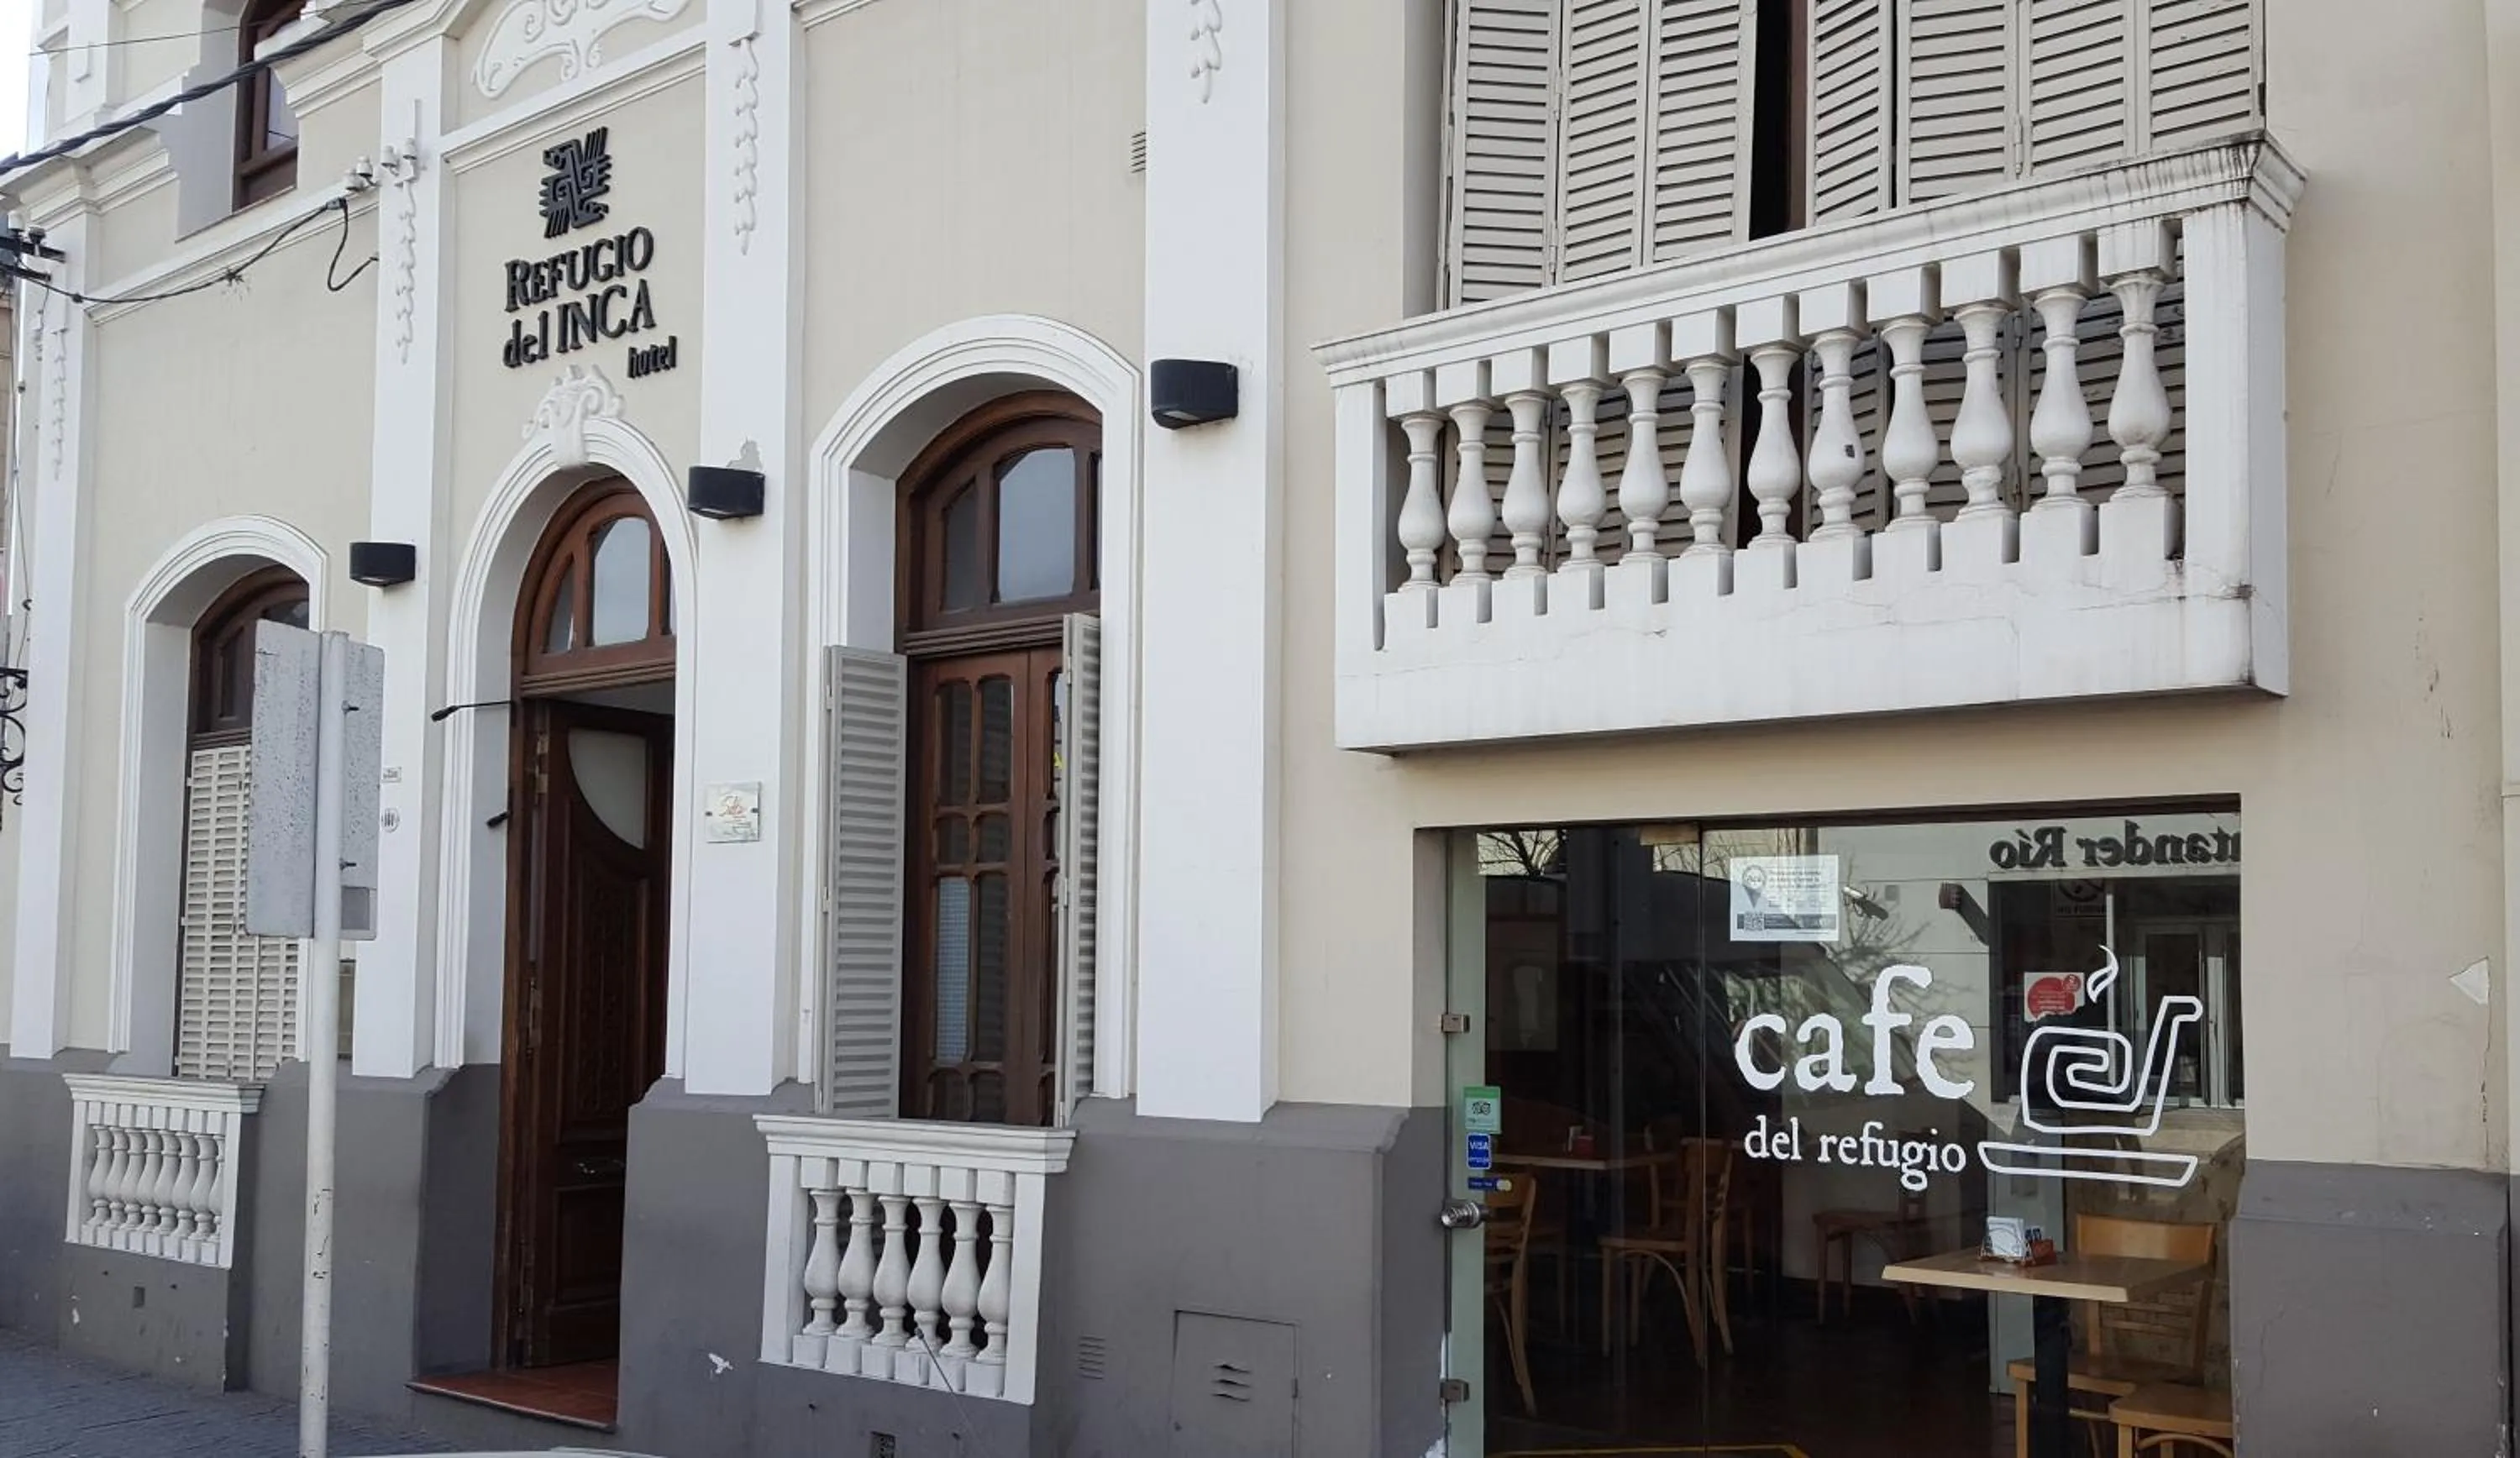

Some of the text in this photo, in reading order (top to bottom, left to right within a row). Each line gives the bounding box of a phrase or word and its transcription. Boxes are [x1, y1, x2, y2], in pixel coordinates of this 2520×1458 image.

[504, 226, 654, 313] REFUGIO
[502, 278, 657, 370] del INCA
[627, 335, 678, 380] hotel
[1735, 964, 1976, 1099] cafe
[1744, 1114, 1966, 1191] del refugio
